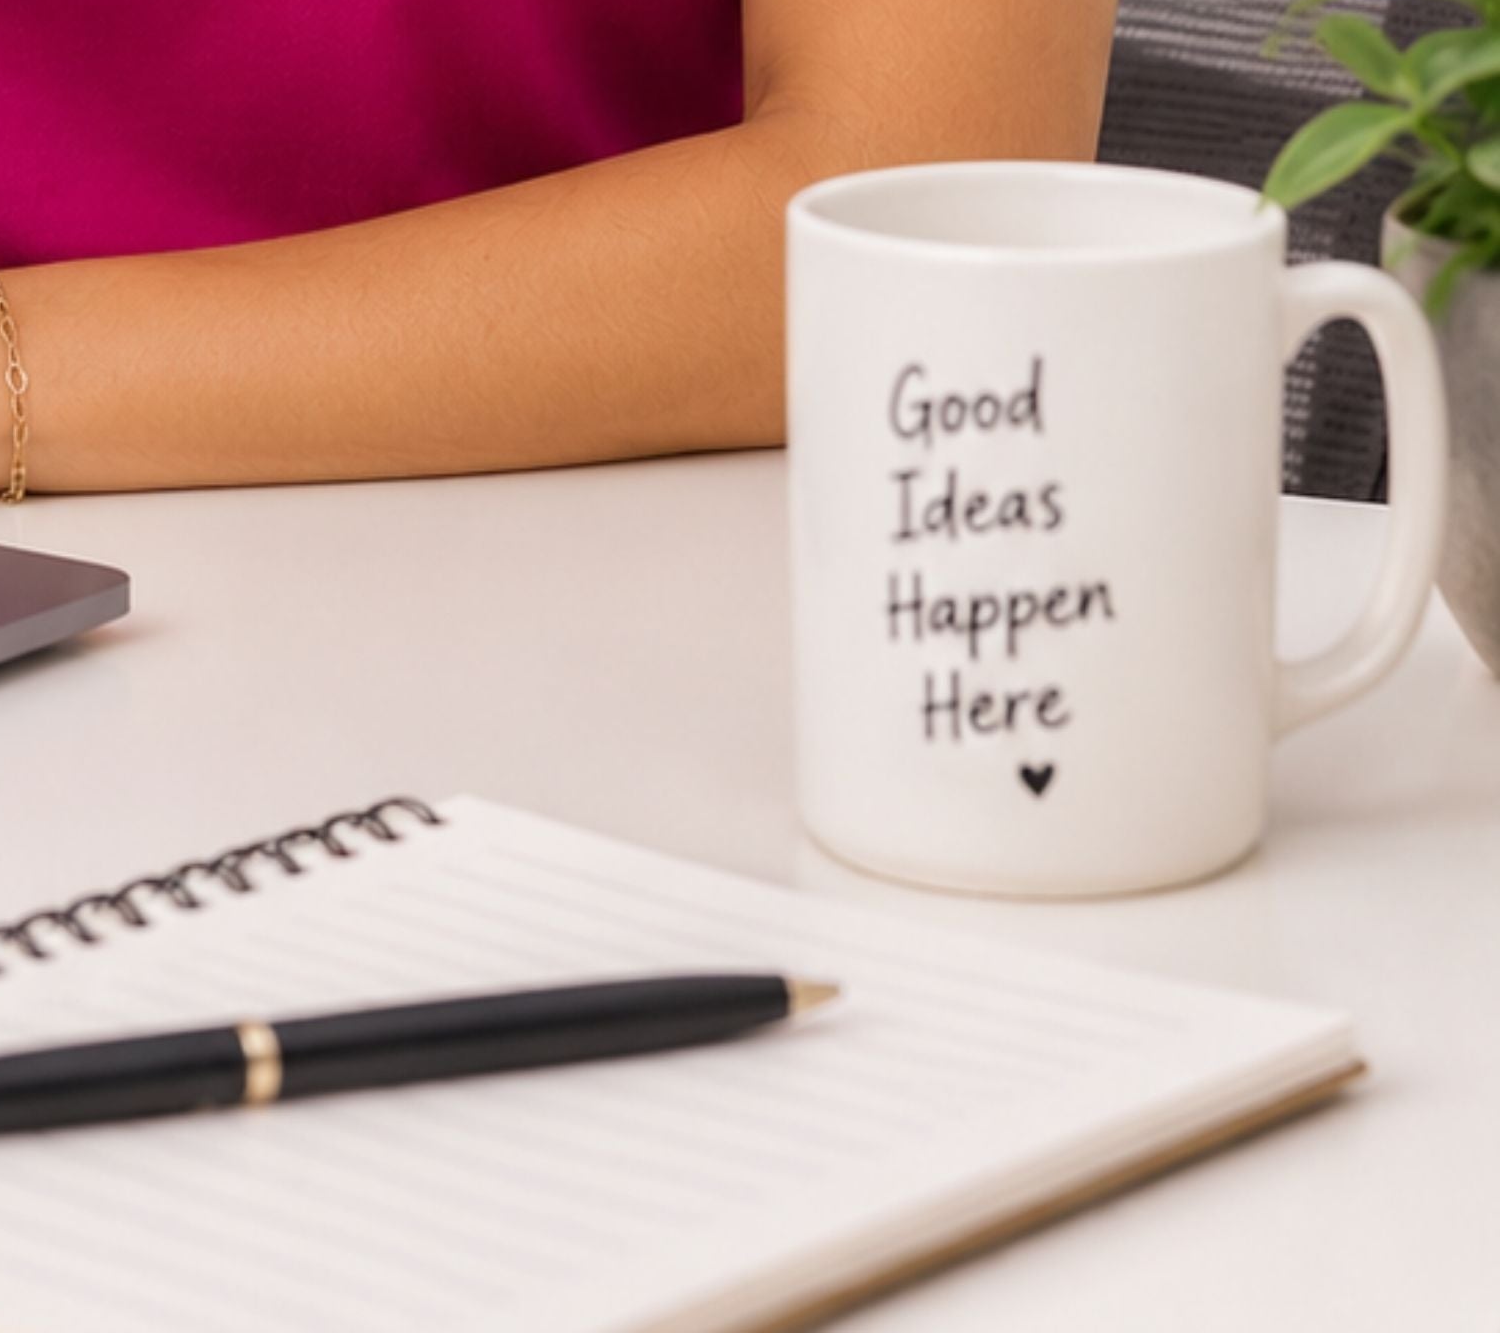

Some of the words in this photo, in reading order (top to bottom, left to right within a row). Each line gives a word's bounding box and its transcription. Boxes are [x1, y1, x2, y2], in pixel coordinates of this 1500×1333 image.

[888, 353, 1046, 449] Good
[892, 467, 1065, 544] Ideas
[885, 573, 1117, 662] Happen
[920, 669, 1072, 741] Here
